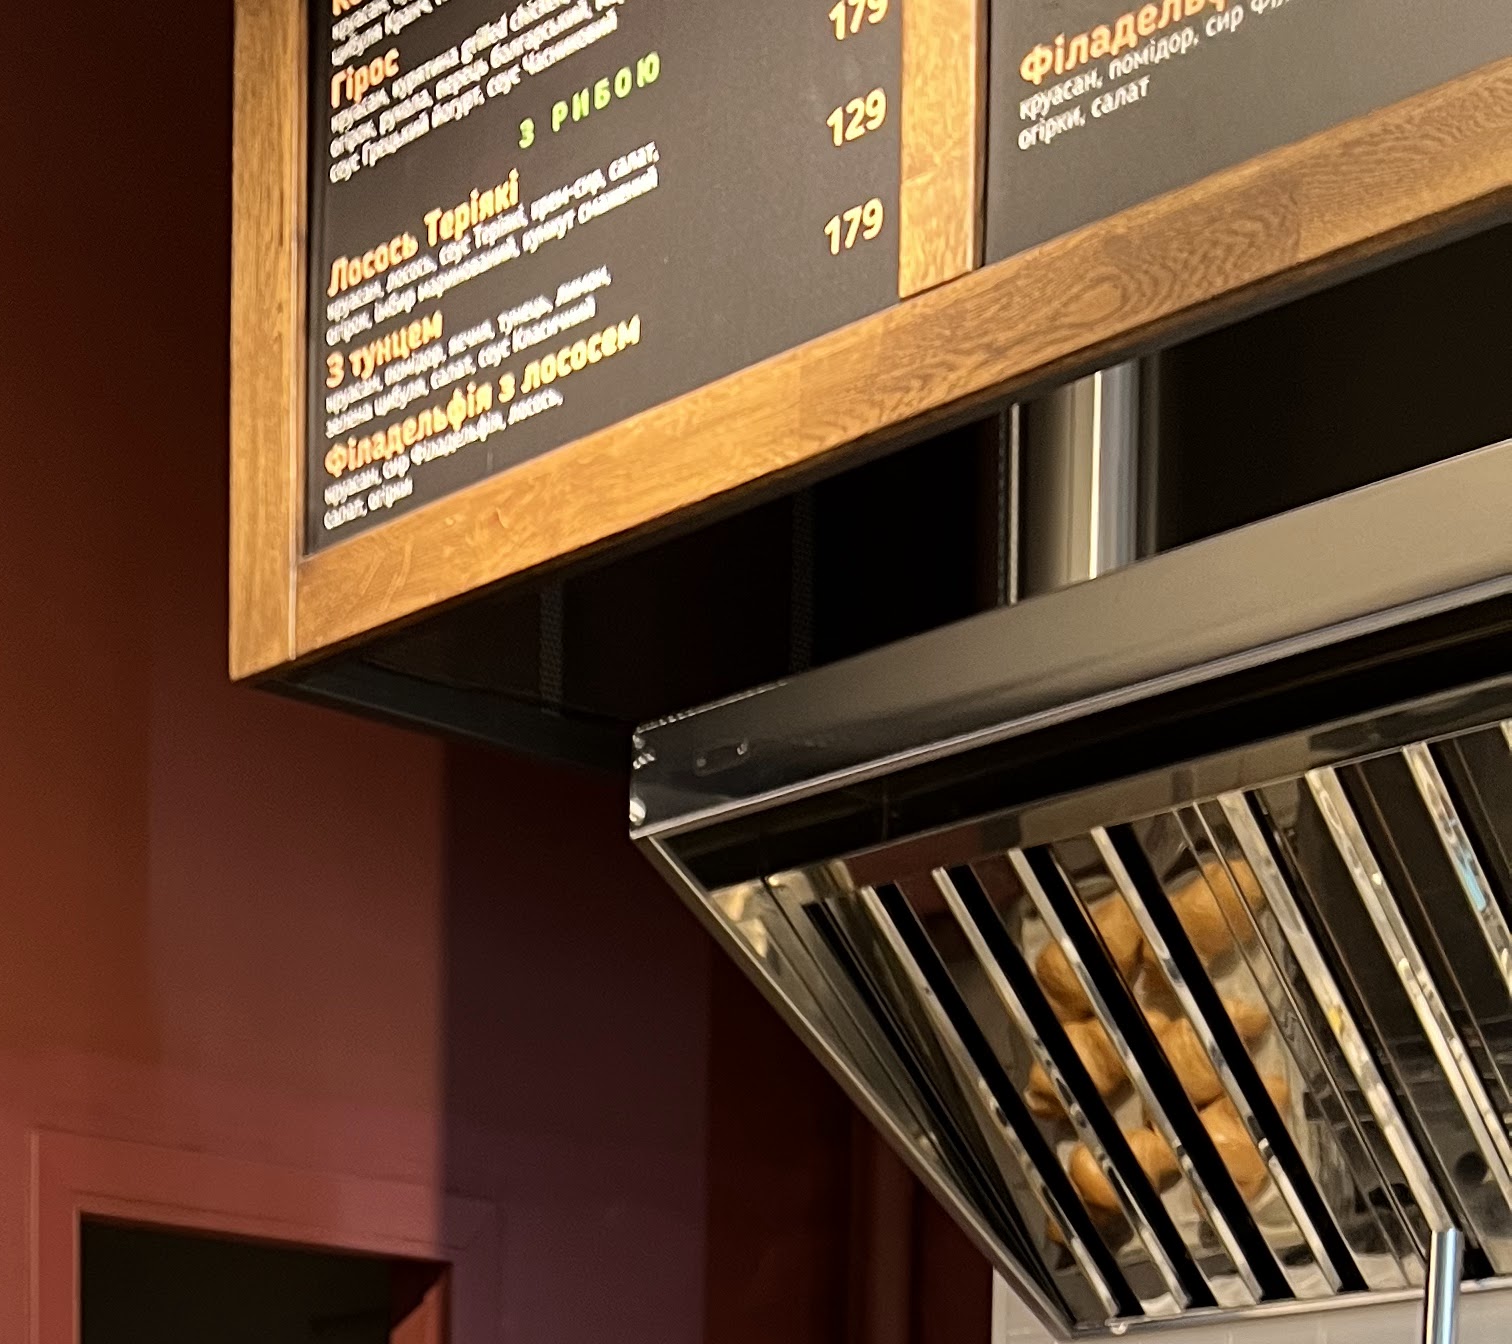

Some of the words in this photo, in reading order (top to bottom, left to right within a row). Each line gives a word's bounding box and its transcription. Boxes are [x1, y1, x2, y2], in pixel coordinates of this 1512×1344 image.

[829, 0, 888, 40] 179
[1019, 0, 1229, 85] Філадель
[331, 47, 400, 109] Гірос
[551, 51, 661, 132] РИБОЮ
[1019, 67, 1103, 121] круасан,
[1108, 26, 1199, 80] помідор,
[1206, 5, 1244, 37] сир
[826, 87, 887, 146] 129
[1017, 105, 1086, 150] огірки,
[1091, 75, 1151, 118] салат
[327, 232, 419, 298] Лосось
[423, 168, 520, 247] Теріякі
[824, 198, 883, 255] 179
[348, 310, 444, 381] тунцем
[324, 380, 493, 478] Філадельфія
[520, 313, 641, 394] лососем
